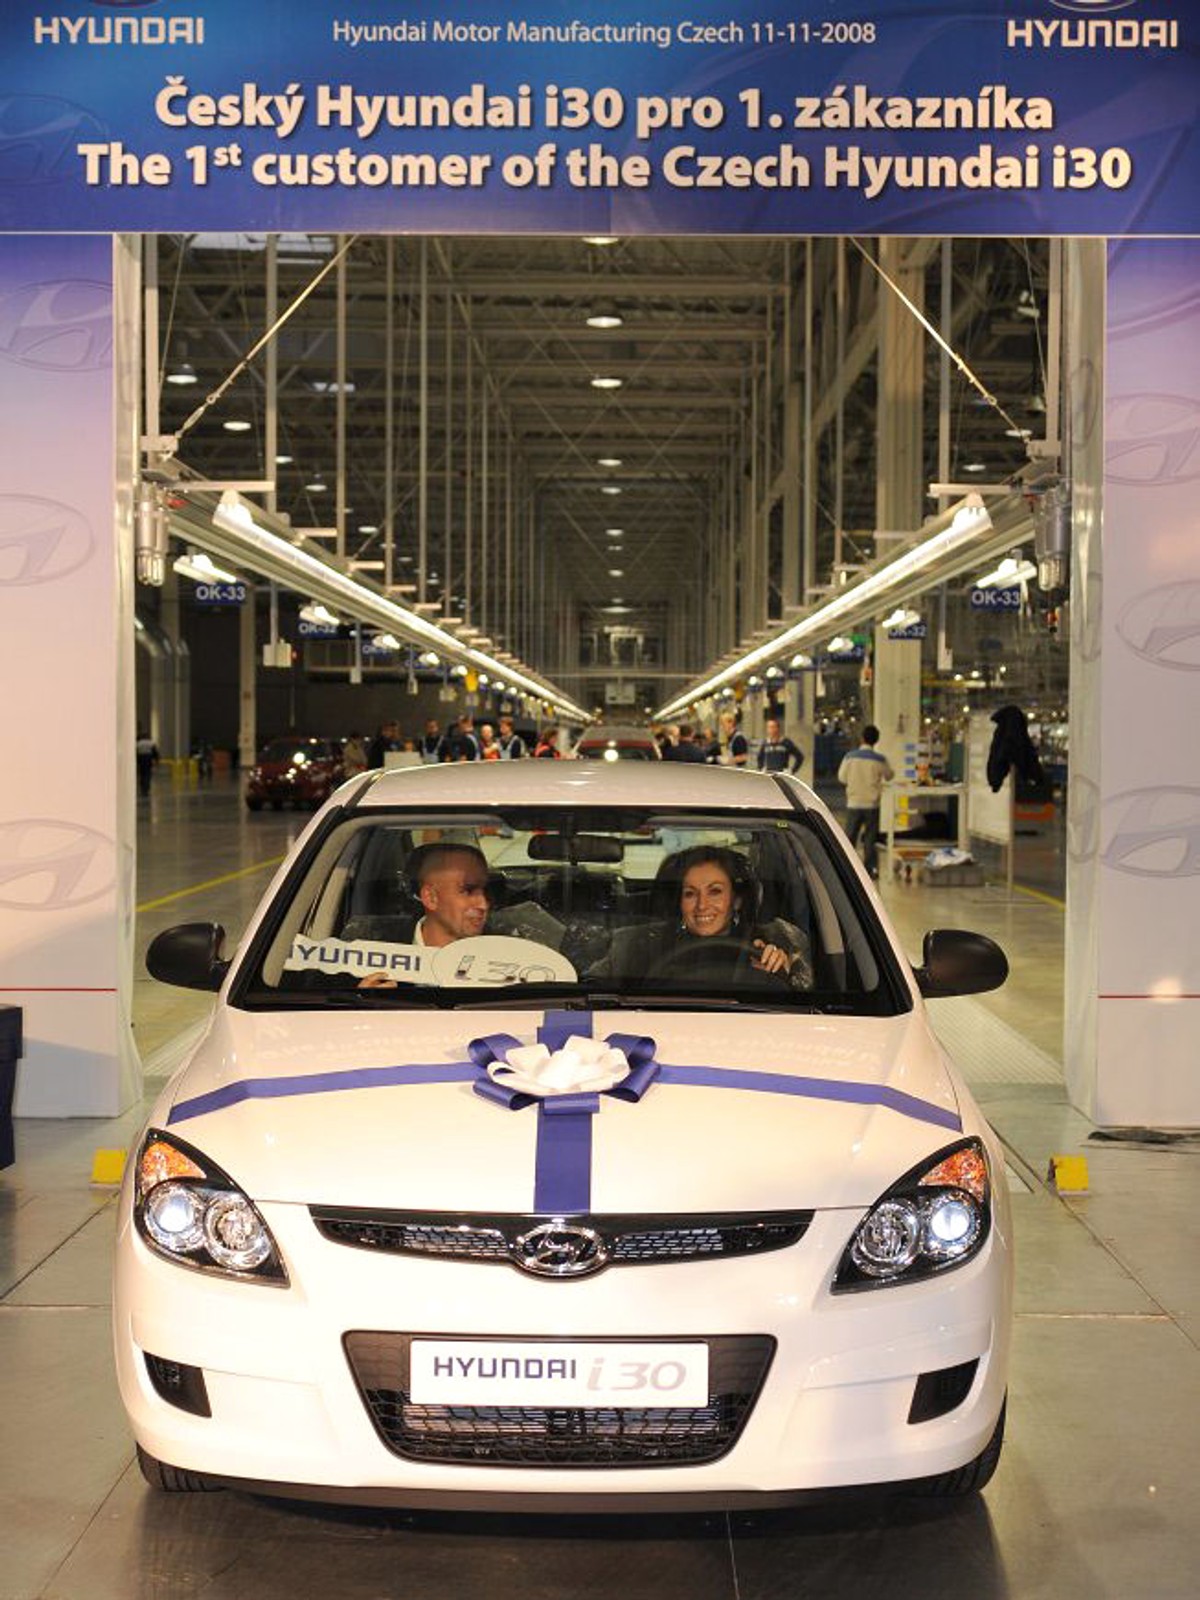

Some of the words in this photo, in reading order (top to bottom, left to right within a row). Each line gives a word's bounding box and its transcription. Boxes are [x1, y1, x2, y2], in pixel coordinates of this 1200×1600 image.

[34, 17, 204, 44] HYUNDAI
[333, 20, 426, 46] Hyundai
[433, 21, 501, 42] Motor
[507, 20, 671, 48] Manufacturing
[676, 21, 744, 43] Czech
[751, 22, 876, 43] 11-11-2008
[1007, 20, 1178, 48] HYUNDAI
[155, 75, 305, 138] Český
[317, 84, 531, 139] Hyundai
[545, 84, 624, 127] i30
[636, 96, 724, 138] pro
[739, 88, 783, 128] 1.
[794, 85, 1053, 129] zákazníka
[77, 143, 171, 185] The
[252, 147, 491, 186] customer
[501, 143, 556, 187] of
[565, 143, 650, 187] the
[662, 144, 810, 187] Czech
[825, 144, 1039, 199] Hyundai
[1052, 144, 1132, 189] i30
[196, 585, 246, 600] OK-33
[971, 590, 1020, 605] OK-33
[289, 944, 422, 971] YUNDAI
[433, 1355, 576, 1379] HYUNDAI
[586, 1357, 687, 1391] i30
